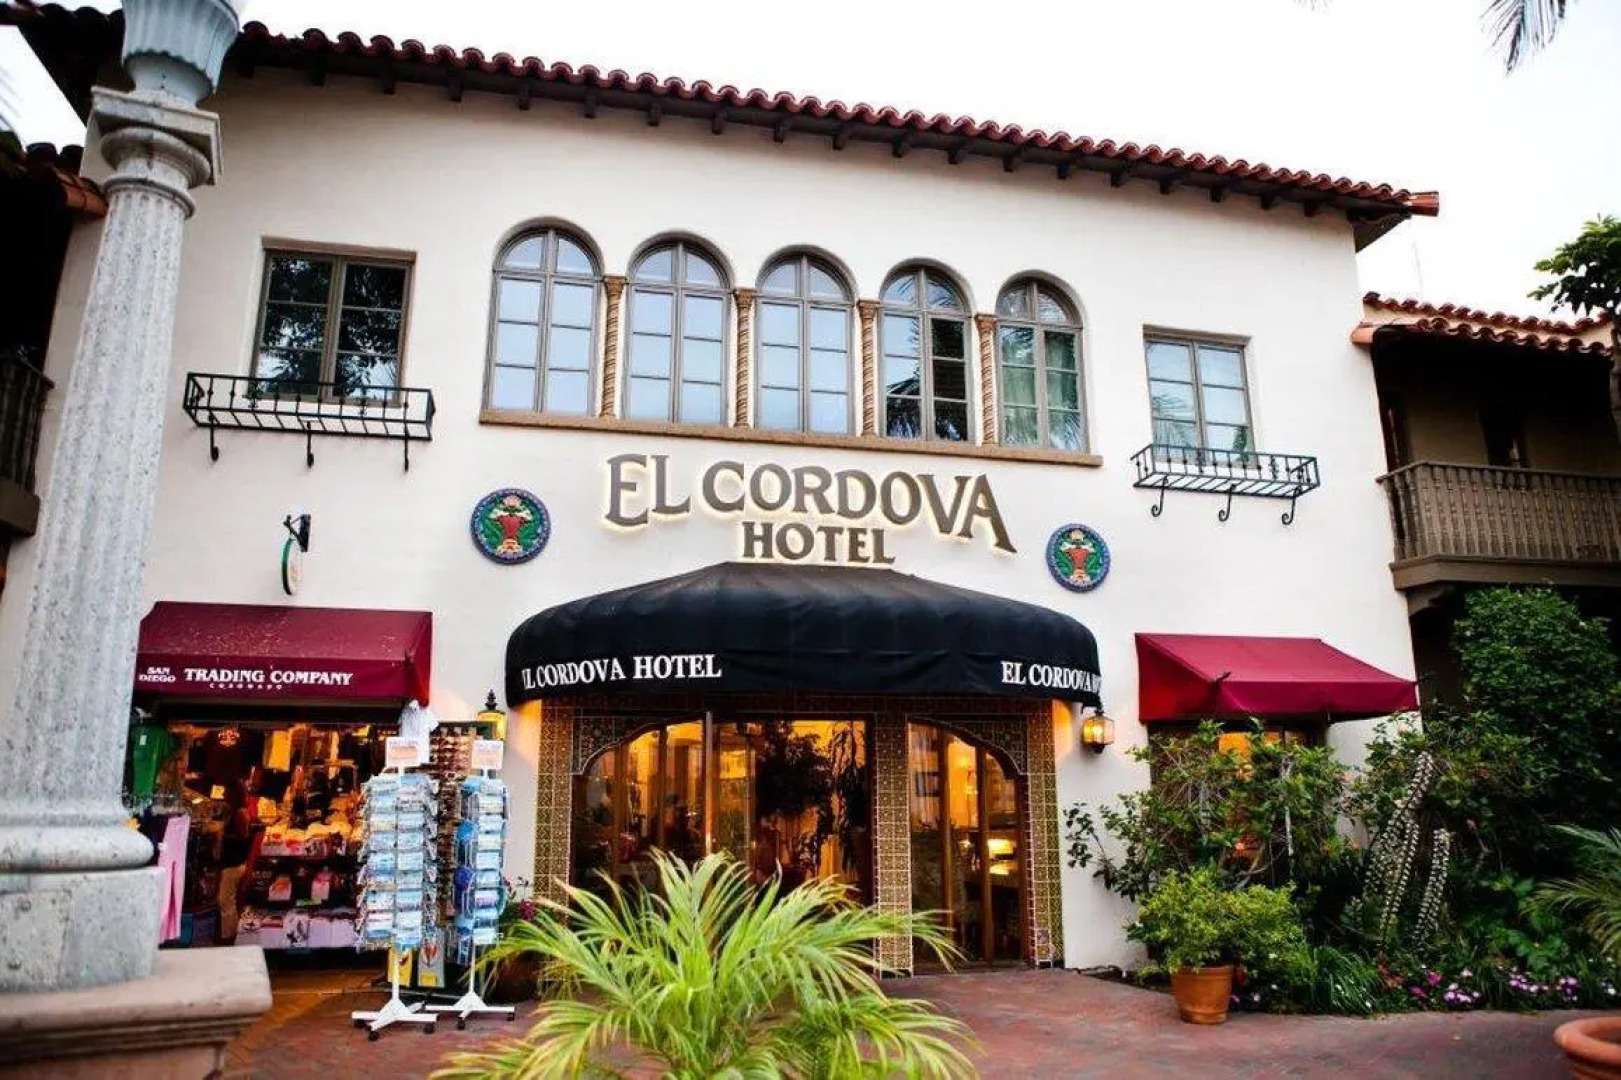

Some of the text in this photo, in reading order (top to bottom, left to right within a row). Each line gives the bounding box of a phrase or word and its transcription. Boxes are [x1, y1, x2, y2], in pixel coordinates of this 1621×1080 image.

[604, 453, 1018, 554] EL CORDOVA
[741, 520, 896, 565] HOTEL
[138, 674, 176, 683] DIEGO
[146, 666, 171, 674] SAN
[184, 667, 353, 685] TRADING COMPANY
[536, 657, 626, 687] CORDOVA
[632, 654, 723, 680] HOTEL
[1001, 661, 1026, 684] EL
[1029, 664, 1092, 691] CORDOVA
